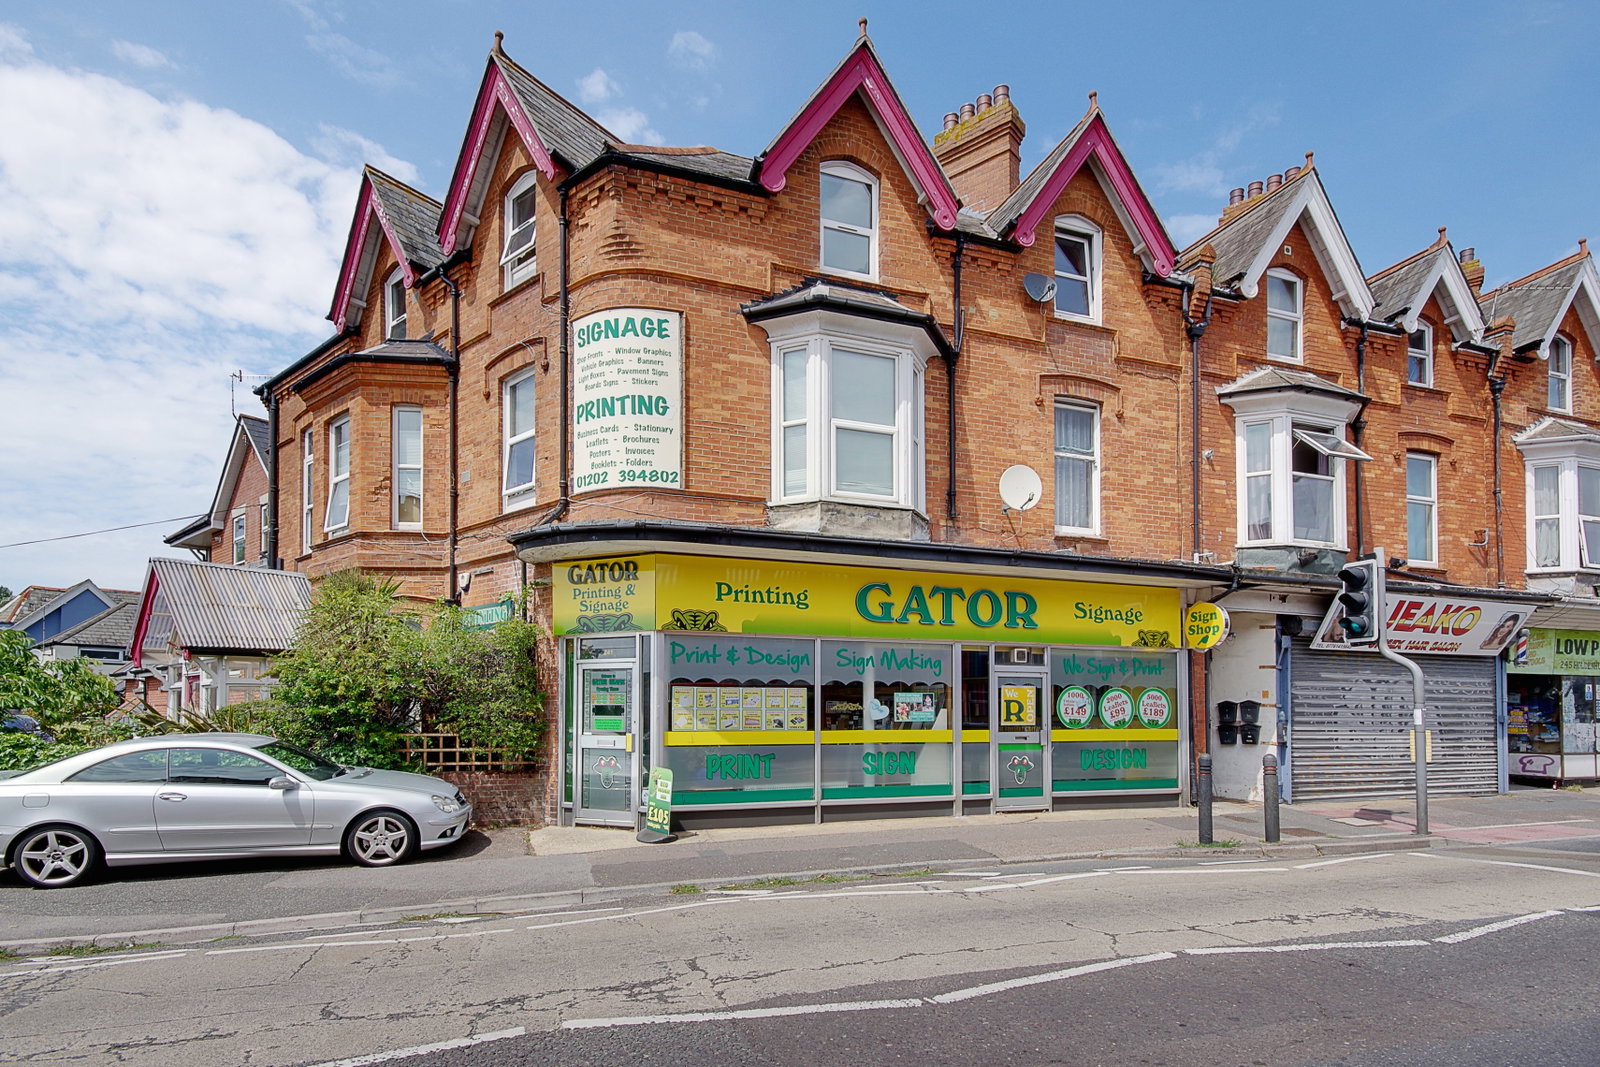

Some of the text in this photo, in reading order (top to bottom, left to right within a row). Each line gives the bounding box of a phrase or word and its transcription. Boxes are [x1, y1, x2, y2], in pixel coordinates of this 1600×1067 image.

[577, 317, 670, 348] SIGNAGE
[577, 356, 586, 365] Shop
[587, 351, 603, 360] Fronts
[643, 347, 672, 357] Graphics
[581, 363, 597, 372] Vehicle
[599, 359, 624, 368] Graphics
[637, 357, 664, 366] Banners
[578, 375, 589, 384] Light
[590, 371, 605, 379] Boxes
[652, 368, 669, 377] Signs
[584, 382, 601, 391] Boards
[603, 379, 619, 388] Signs
[632, 378, 658, 386] Stickers
[576, 394, 670, 424] PRINTING
[577, 429, 598, 439] Business
[600, 424, 619, 434] Cards
[634, 423, 674, 434] Stationary
[586, 438, 608, 448] Leaflets
[622, 435, 660, 444] Brochures
[589, 450, 611, 459] Posters
[625, 447, 655, 455] Invoices
[591, 460, 617, 470] Booklets
[626, 458, 653, 467] Folders
[576, 469, 679, 488] 01202 394802
[567, 560, 640, 585] GATOR
[572, 583, 636, 600] Printing &
[715, 581, 810, 610] Printing
[579, 599, 629, 613] Signage
[855, 581, 1039, 629] GATOR
[1073, 601, 1144, 626] Signage
[1190, 611, 1217, 624] Sign
[1188, 624, 1220, 635] Shop
[1404, 640, 1430, 650] HAIR
[1429, 641, 1462, 651] SALON
[1555, 638, 1589, 655] LOW
[670, 641, 810, 673] Print & Design
[836, 648, 942, 677] Sign Making
[1560, 660, 1573, 669] 245
[1063, 654, 1165, 681] We Sign & Print
[1004, 689, 1019, 698] We
[1106, 693, 1123, 703] 2000
[1003, 699, 1025, 722] R
[1026, 689, 1035, 722] OPEN
[1063, 706, 1087, 715] £149
[1103, 700, 1129, 712] Leaflets
[1142, 700, 1166, 709] Leaflets
[1142, 707, 1164, 717] £189
[1110, 707, 1126, 719] £99
[706, 753, 776, 780] PRINT
[862, 751, 916, 776] SIGN
[1080, 748, 1147, 771] DESIGN
[648, 806, 669, 824] £105
